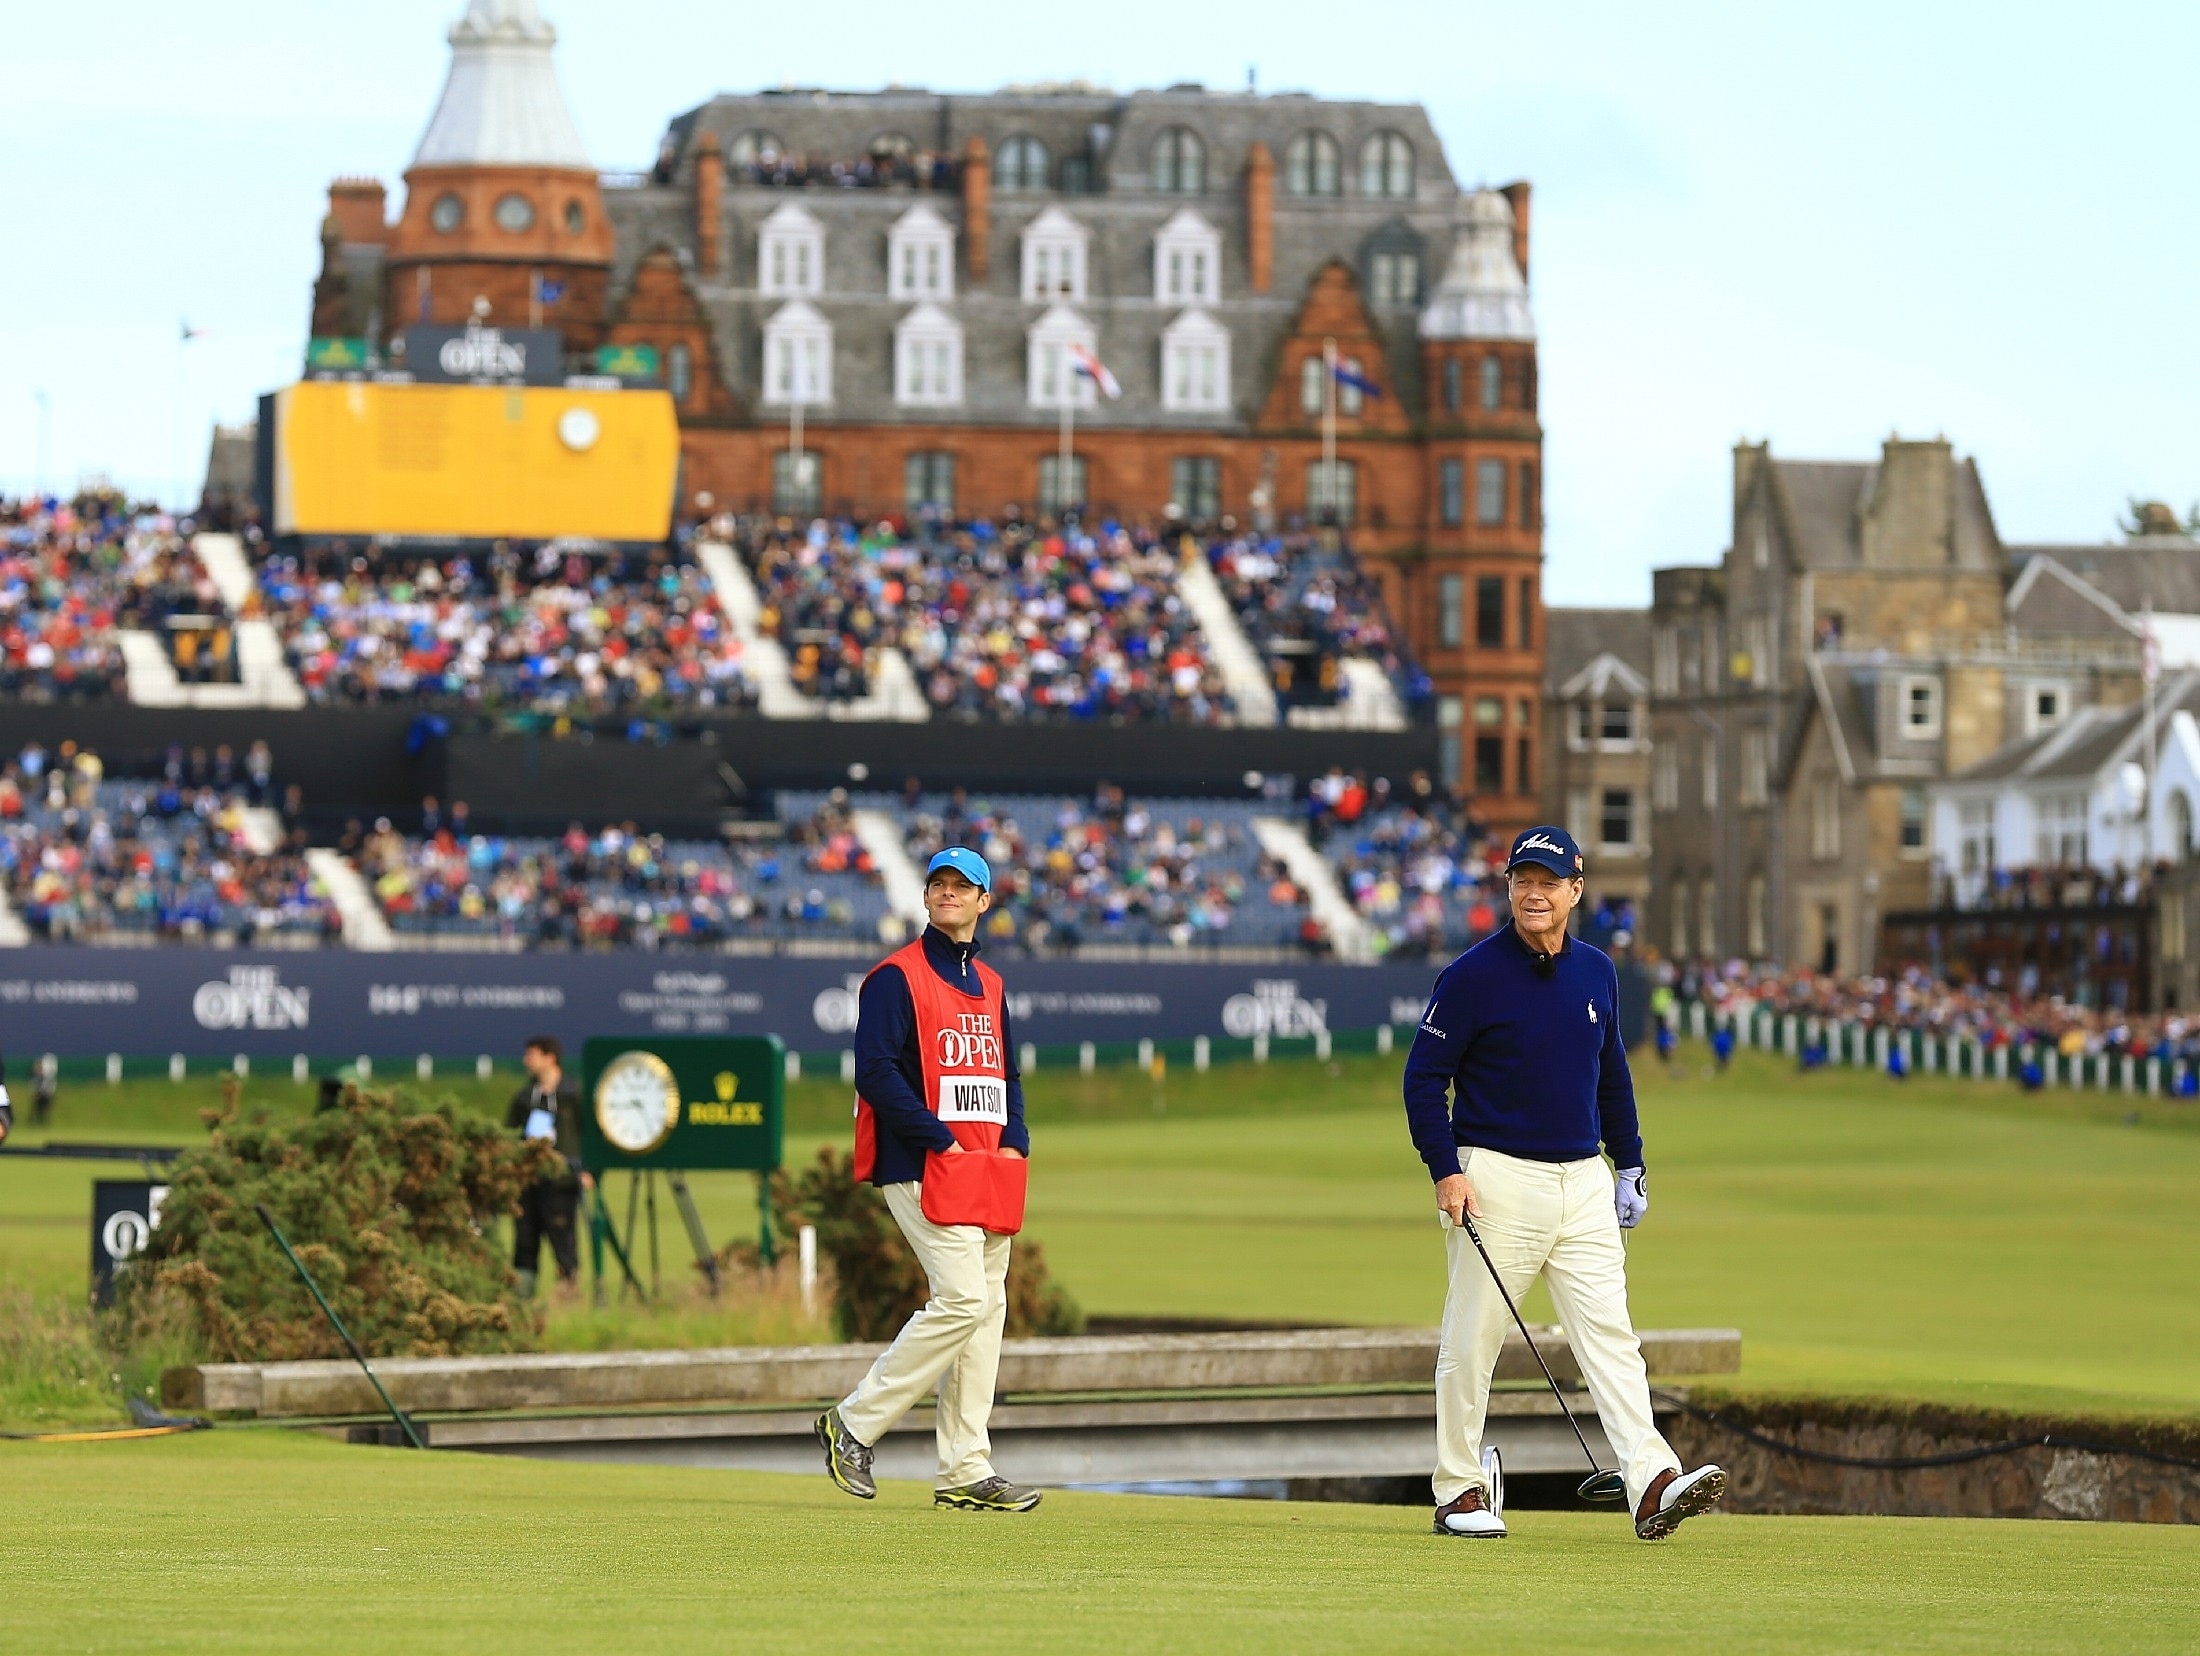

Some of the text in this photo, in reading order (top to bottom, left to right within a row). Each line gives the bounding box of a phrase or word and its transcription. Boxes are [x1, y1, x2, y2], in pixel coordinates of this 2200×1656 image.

[1515, 833, 1564, 855] Adams
[229, 964, 279, 986] THE
[1253, 979, 1300, 999] THE
[192, 980, 310, 1030] OPEN
[1221, 993, 1326, 1039] OPEN
[957, 1013, 993, 1034] THE
[937, 1028, 1002, 1070] OPEN
[688, 1102, 763, 1125] ROLEX
